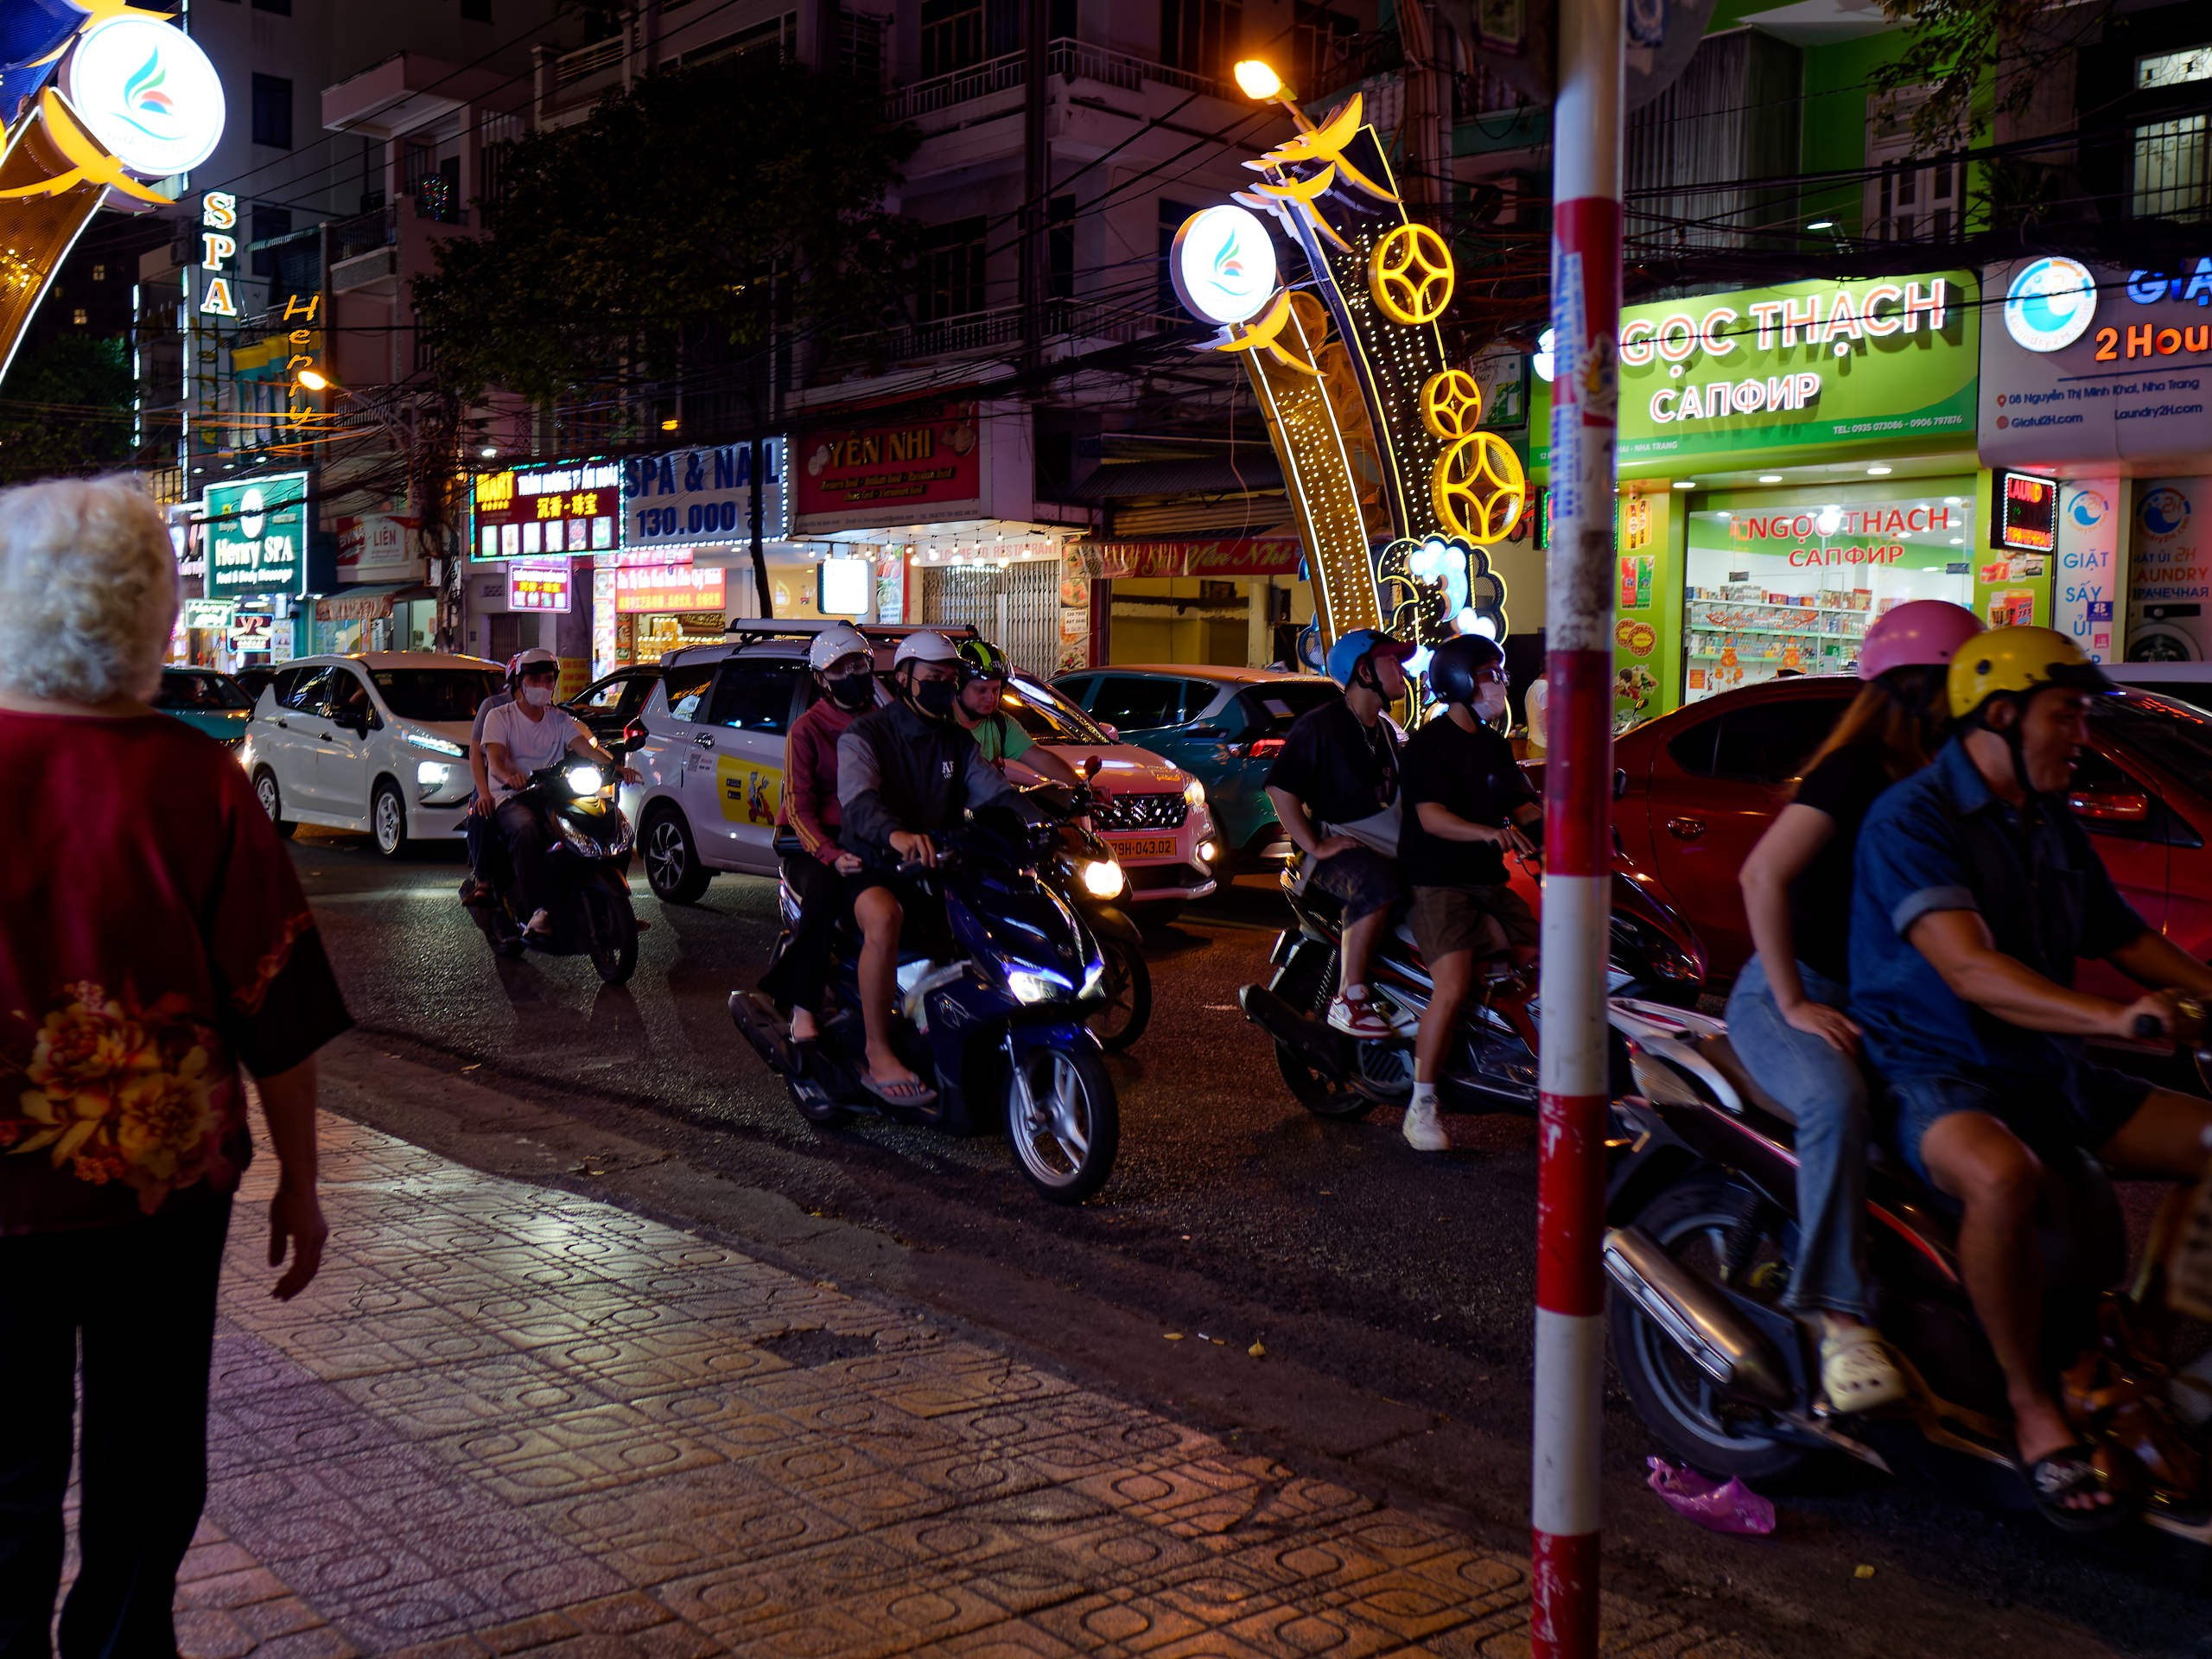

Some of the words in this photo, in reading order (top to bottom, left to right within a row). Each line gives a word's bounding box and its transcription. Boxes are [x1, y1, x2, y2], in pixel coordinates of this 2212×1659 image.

[200, 191, 238, 316] SPA
[1618, 308, 1738, 378] GỌC
[1749, 278, 1946, 358] THẠCH
[2094, 327, 2118, 362] 2
[2126, 323, 2212, 359] Hou
[1649, 372, 1821, 423] САПФИР
[2009, 394, 2022, 404] 08
[2024, 388, 2064, 406] Nguyễn
[2068, 385, 2082, 400] Thị
[2084, 384, 2109, 397] Minh
[2143, 381, 2165, 392] Nha
[2169, 378, 2200, 391] Trang
[2114, 403, 2202, 420] Laundry2H.com
[1833, 425, 1851, 435] TEL:
[1852, 423, 1872, 433] 0935
[888, 429, 933, 461] NHI
[1634, 442, 1651, 451] NHA
[1652, 442, 1678, 450] TRANG
[623, 455, 676, 499] SPA
[684, 453, 706, 492] &
[715, 443, 779, 490] NAL
[2007, 478, 2053, 504] LAUNDY
[636, 501, 736, 537] 130.000
[1842, 507, 1949, 538] THẠCH
[215, 537, 263, 569] Henry
[264, 535, 296, 562] SPA
[994, 541, 1058, 557] RESTARANT
[1789, 545, 1904, 567] САПФИР
[2063, 549, 2109, 571] GIẶT
[2137, 567, 2209, 582] AUNDRY
[2065, 581, 2102, 603] SẤY
